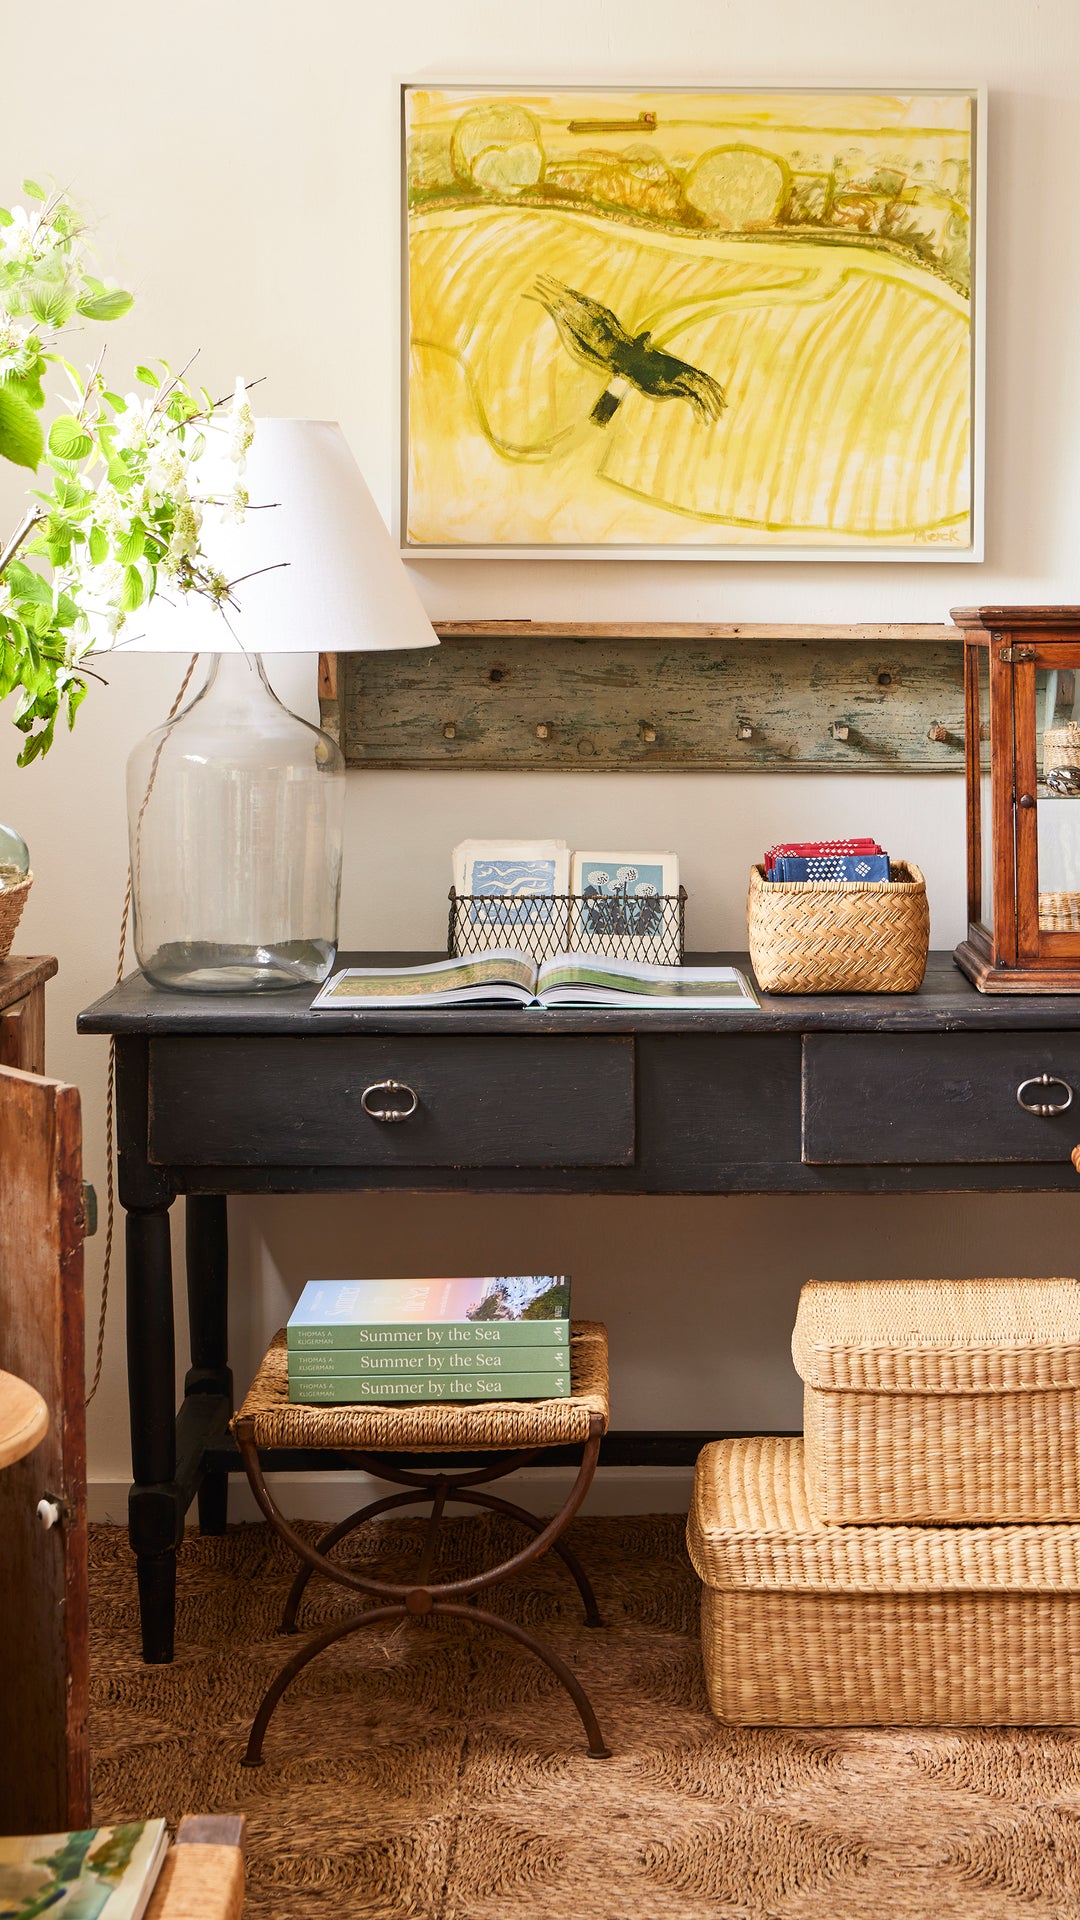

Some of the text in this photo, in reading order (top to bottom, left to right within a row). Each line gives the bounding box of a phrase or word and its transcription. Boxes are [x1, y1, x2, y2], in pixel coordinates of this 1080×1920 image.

[359, 1327, 501, 1345] Summer by the Sea
[360, 1353, 502, 1371] Summer by the Sea
[361, 1379, 502, 1397] Summer by the Sea
